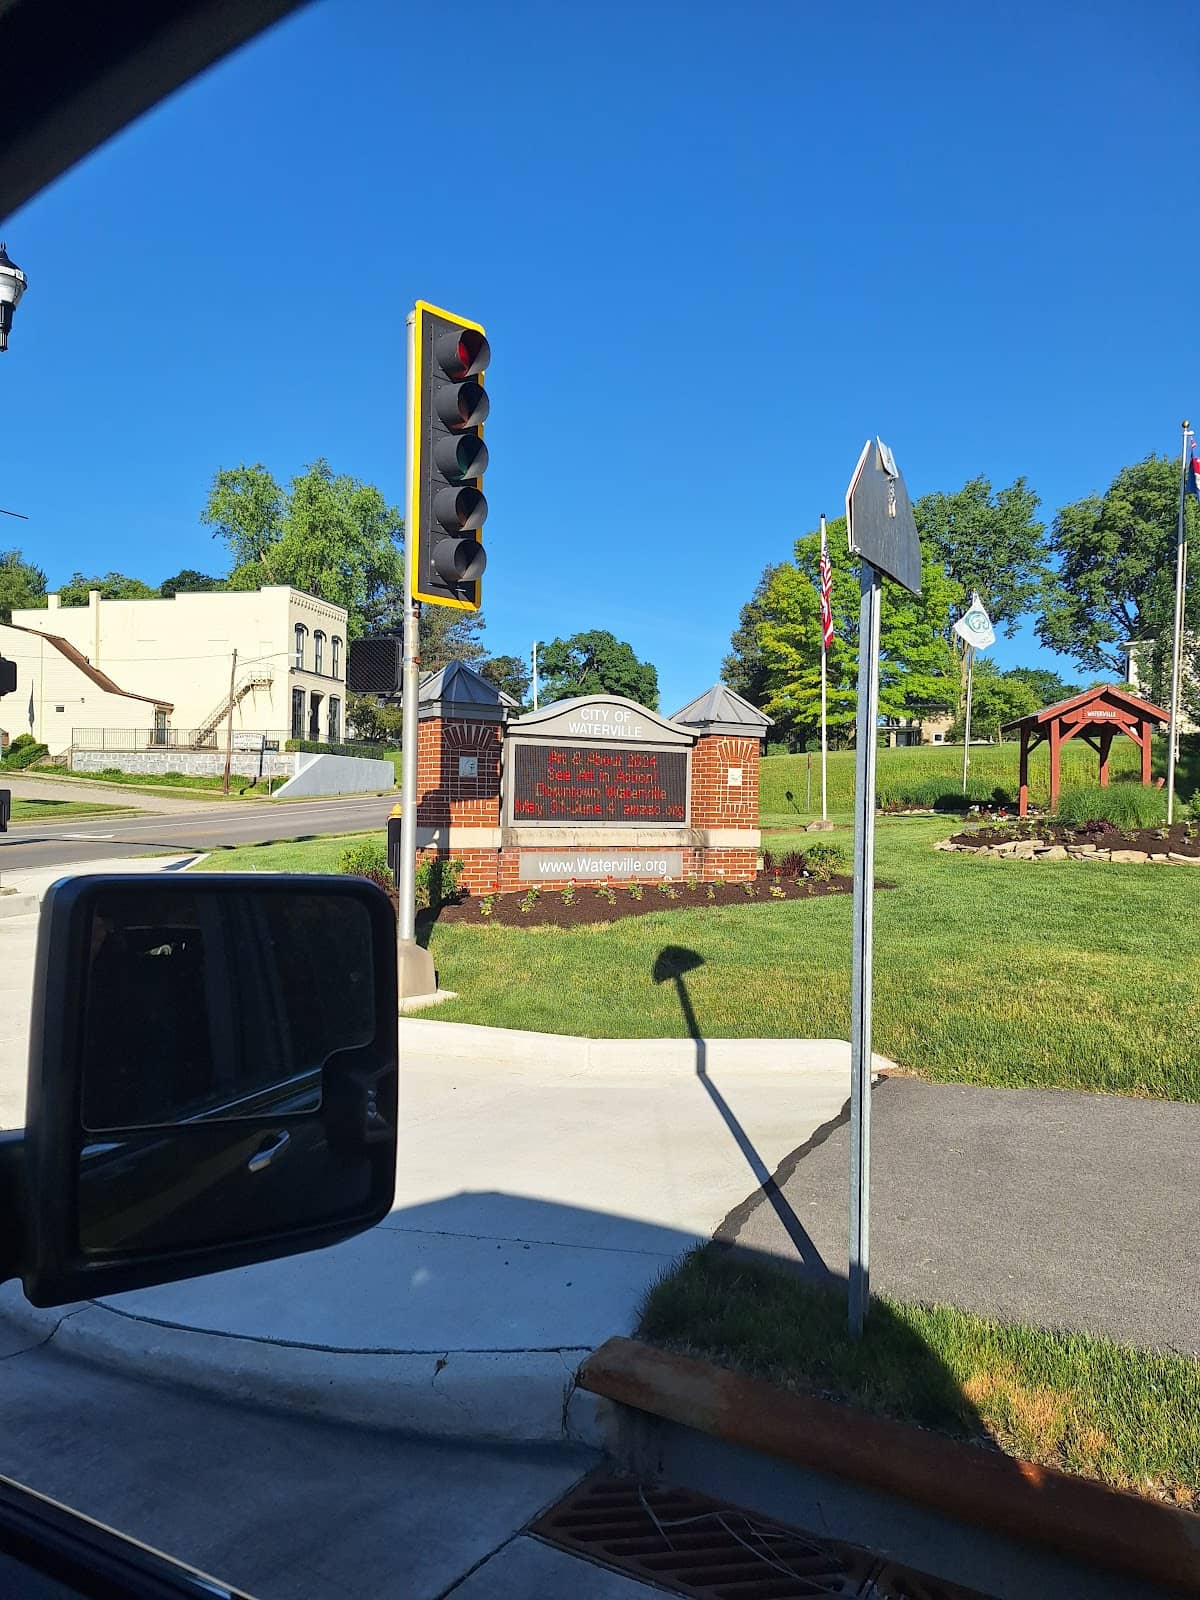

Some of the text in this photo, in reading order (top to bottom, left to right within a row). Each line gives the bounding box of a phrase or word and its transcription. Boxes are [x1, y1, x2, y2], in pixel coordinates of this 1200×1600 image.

[580, 708, 632, 723] CITY OF
[568, 721, 643, 738] WATERVILLE
[548, 767, 571, 781] See
[599, 769, 610, 782] in
[536, 782, 667, 801] Downtown Waterville
[515, 799, 543, 817] May
[539, 857, 667, 874] www.Waterville.org
